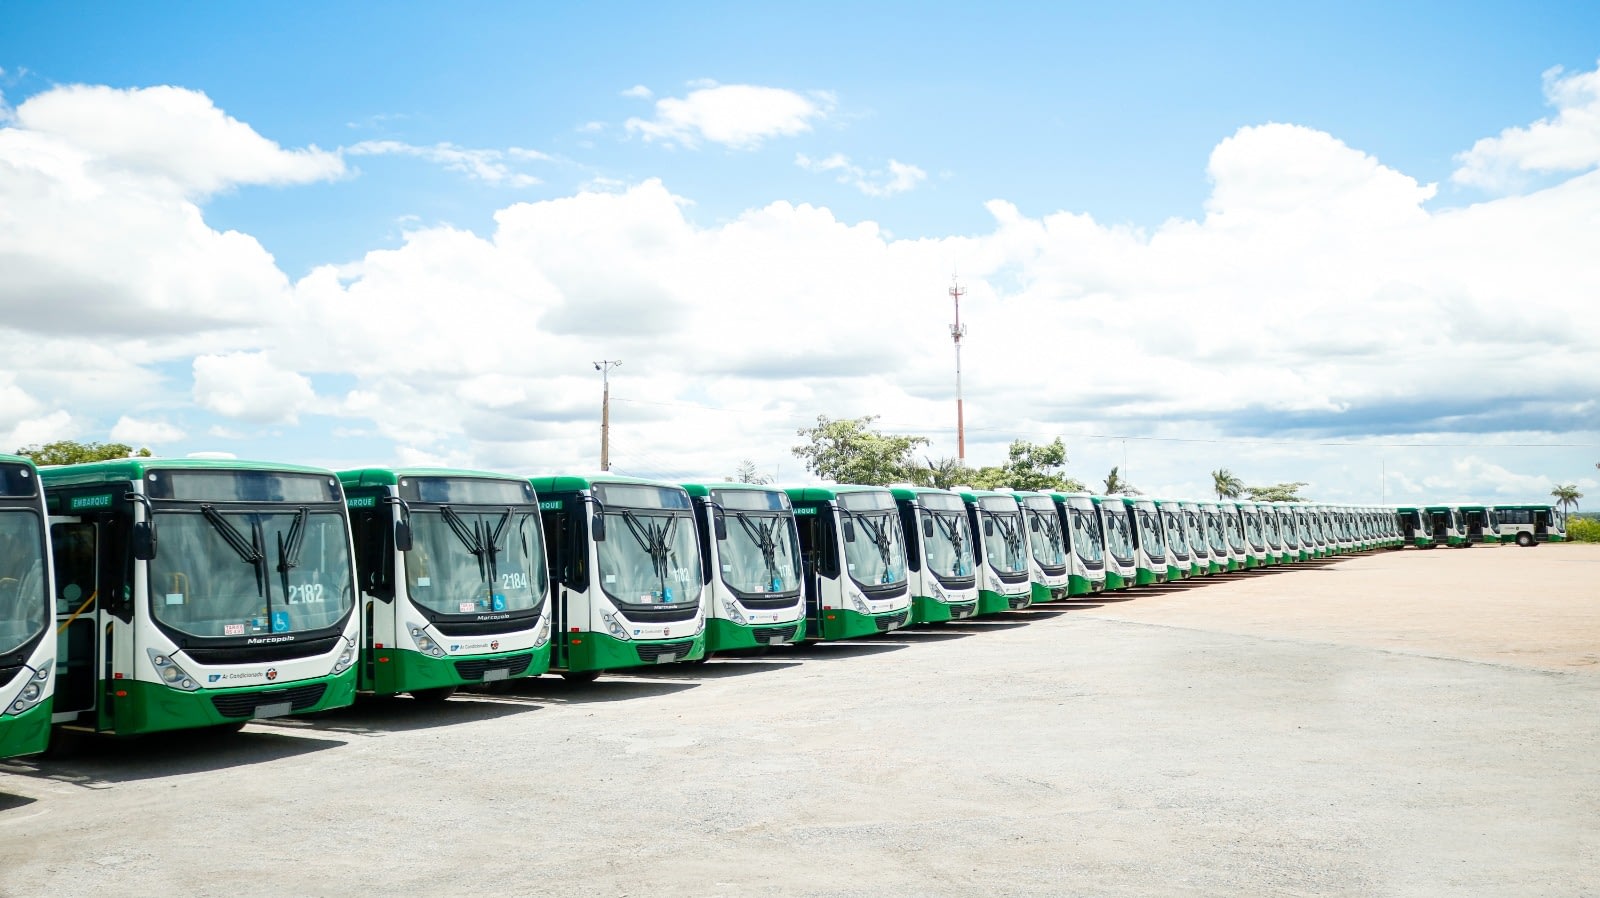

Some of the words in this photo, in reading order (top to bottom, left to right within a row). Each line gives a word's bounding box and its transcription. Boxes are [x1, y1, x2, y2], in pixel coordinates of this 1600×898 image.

[73, 496, 109, 507] EMBARQUE
[347, 498, 372, 507] ARQUE
[673, 567, 690, 582] 1182
[502, 572, 527, 590] 2184
[288, 583, 325, 605] 2182
[247, 635, 295, 644] Marcopolo
[229, 671, 263, 679] Condicionado
